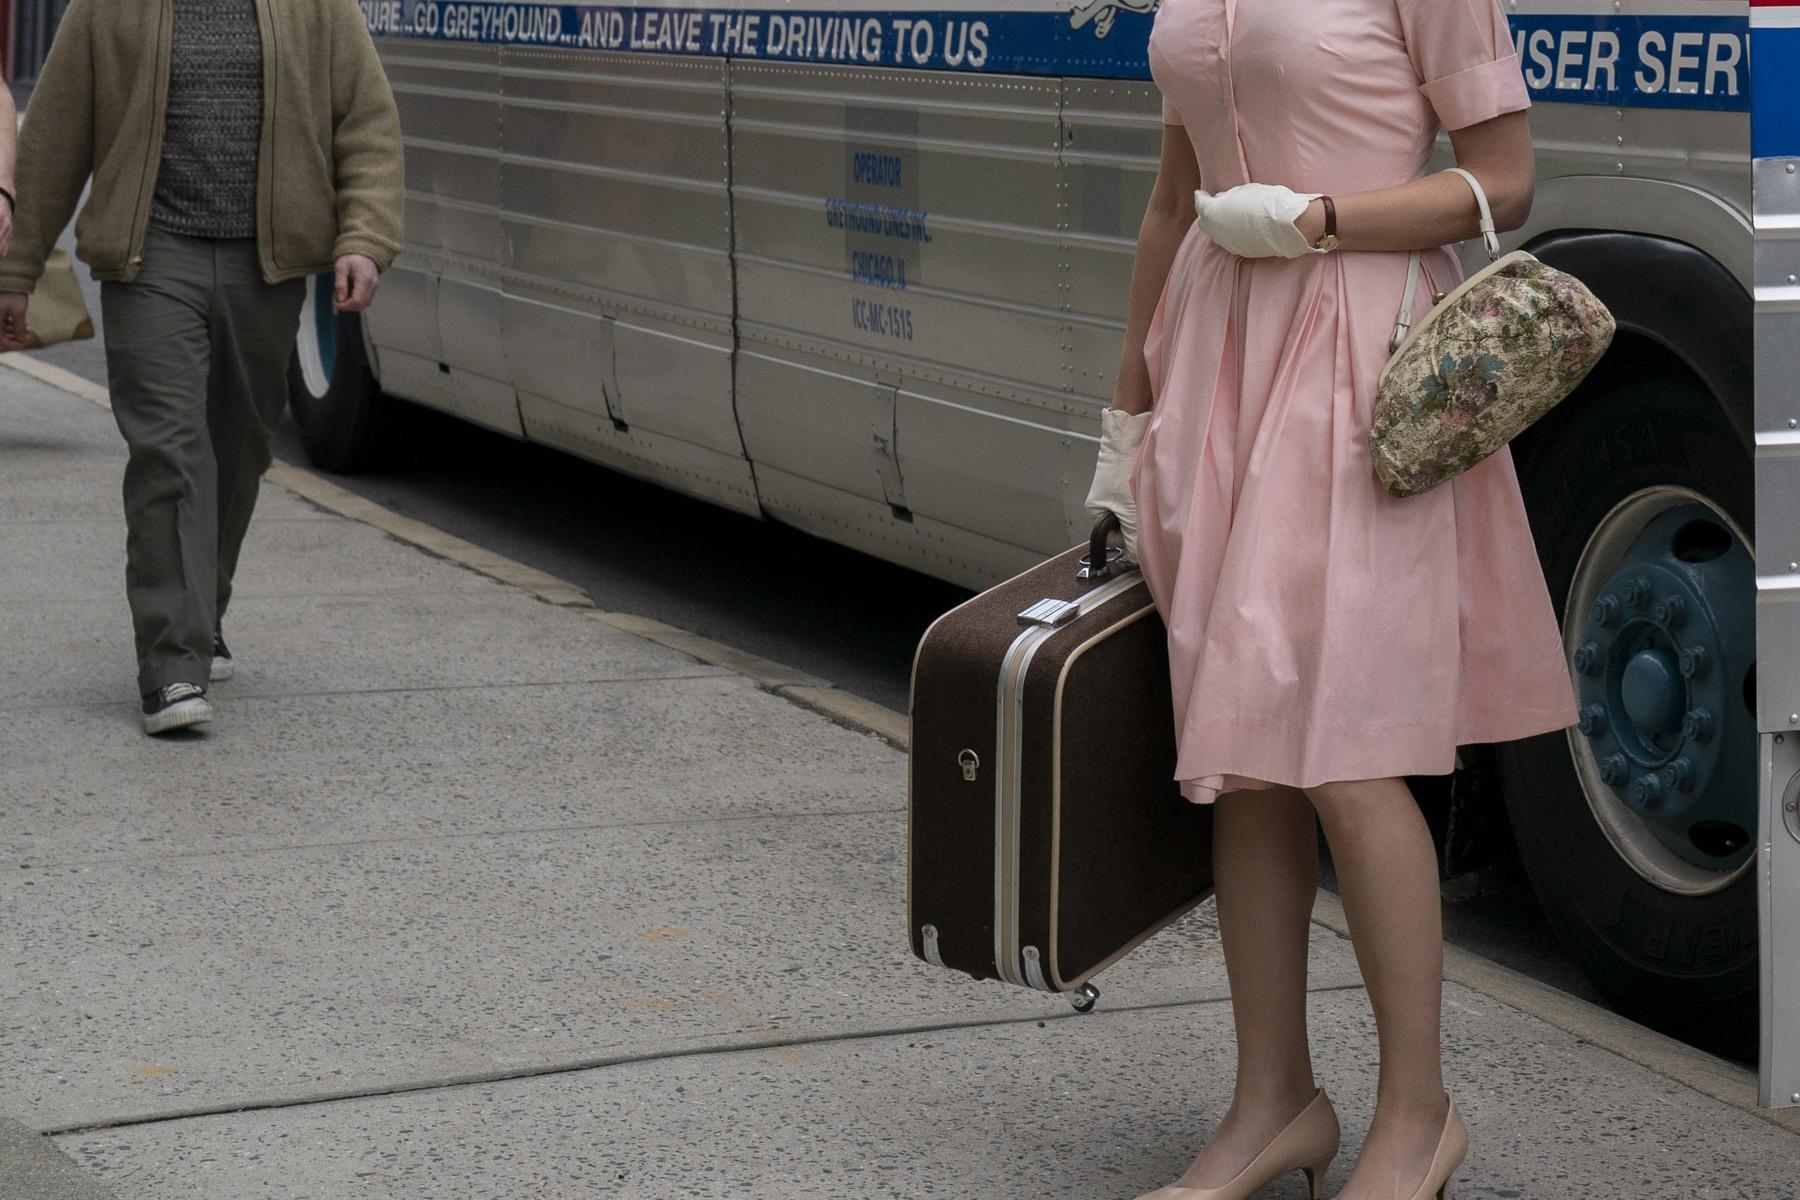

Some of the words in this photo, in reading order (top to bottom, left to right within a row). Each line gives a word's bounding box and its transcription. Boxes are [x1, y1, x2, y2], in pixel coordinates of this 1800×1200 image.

[631, 7, 702, 51] LEAVE
[710, 11, 758, 55] THE
[766, 13, 882, 61] DRIVING
[893, 18, 934, 64] TO
[945, 21, 988, 68] US
[1634, 30, 1750, 97] SER
[854, 151, 901, 188] OPERATOR
[825, 197, 881, 236] GREYHOUND
